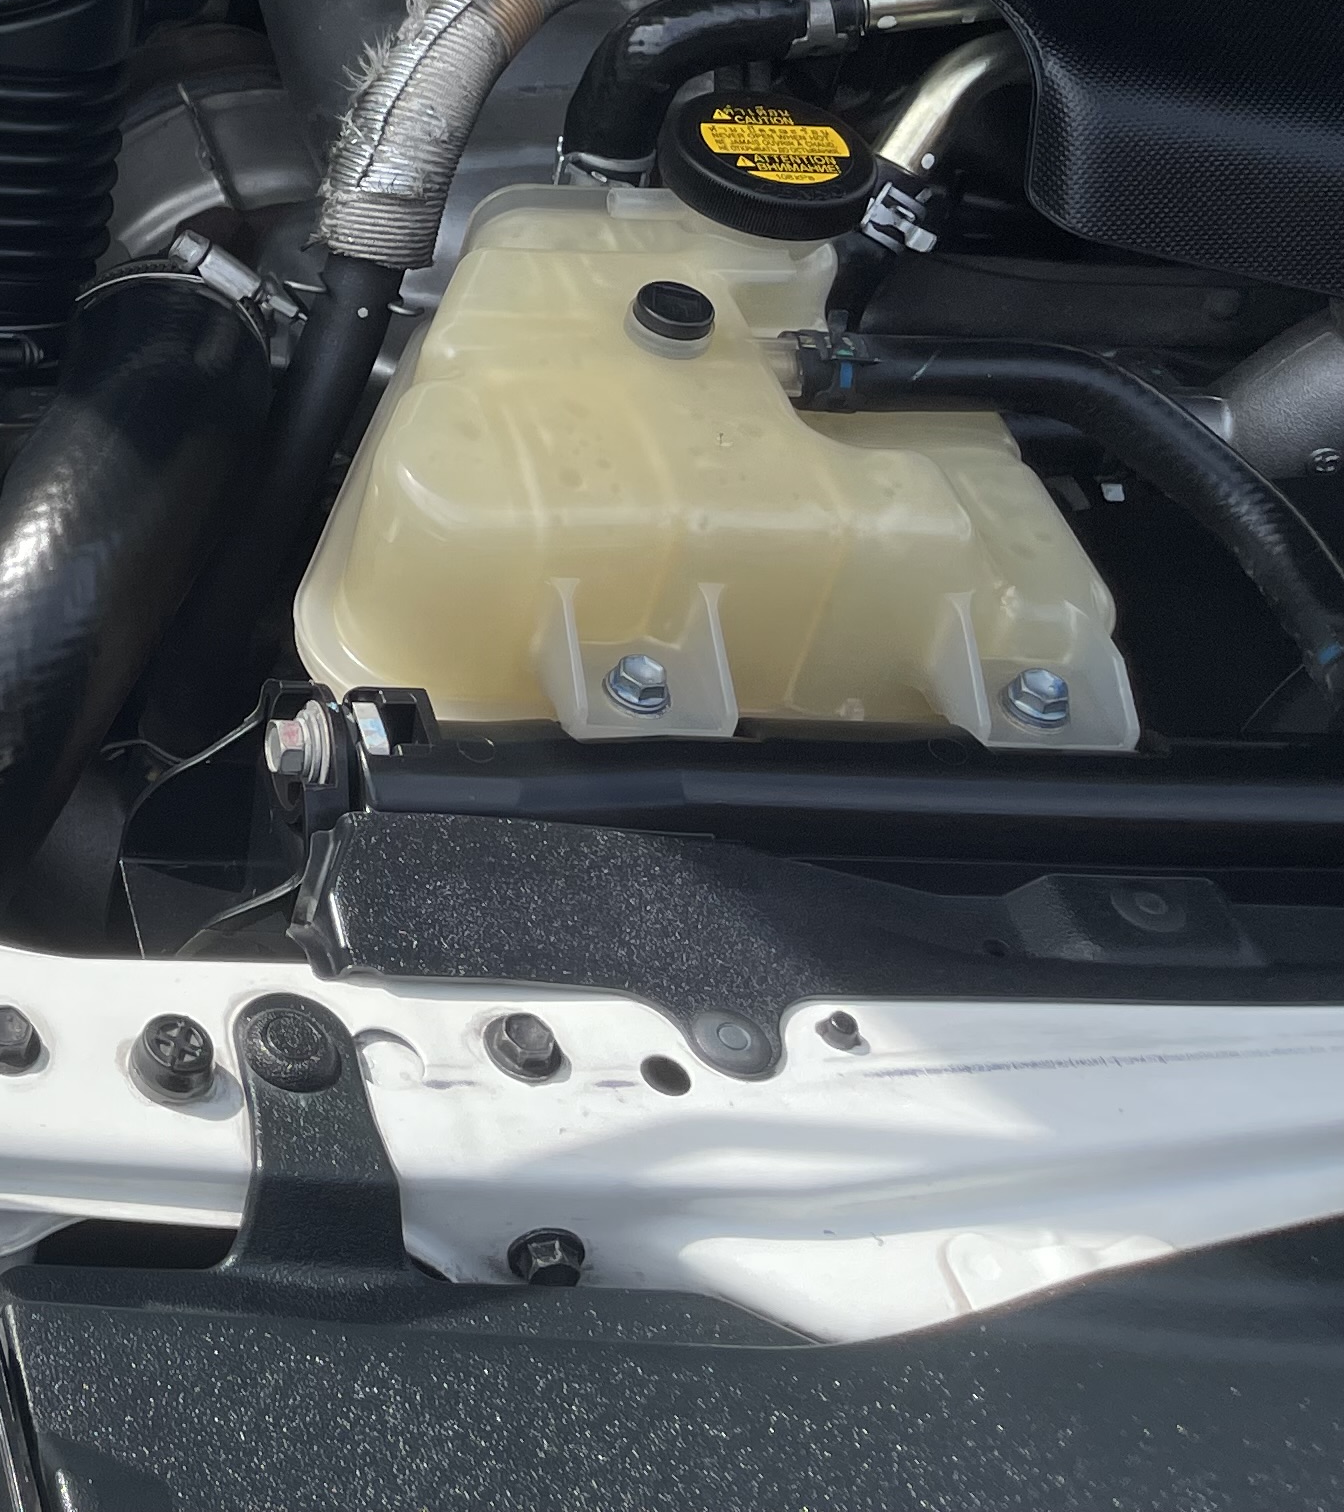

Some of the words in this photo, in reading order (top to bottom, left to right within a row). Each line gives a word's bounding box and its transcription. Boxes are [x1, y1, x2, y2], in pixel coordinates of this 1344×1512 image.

[734, 116, 794, 125] CAUTION
[712, 132, 745, 140] NEVER
[747, 133, 775, 141] OPEN
[753, 154, 837, 165] ATTENTION
[757, 162, 842, 174] ВНИМАНИЕ!
